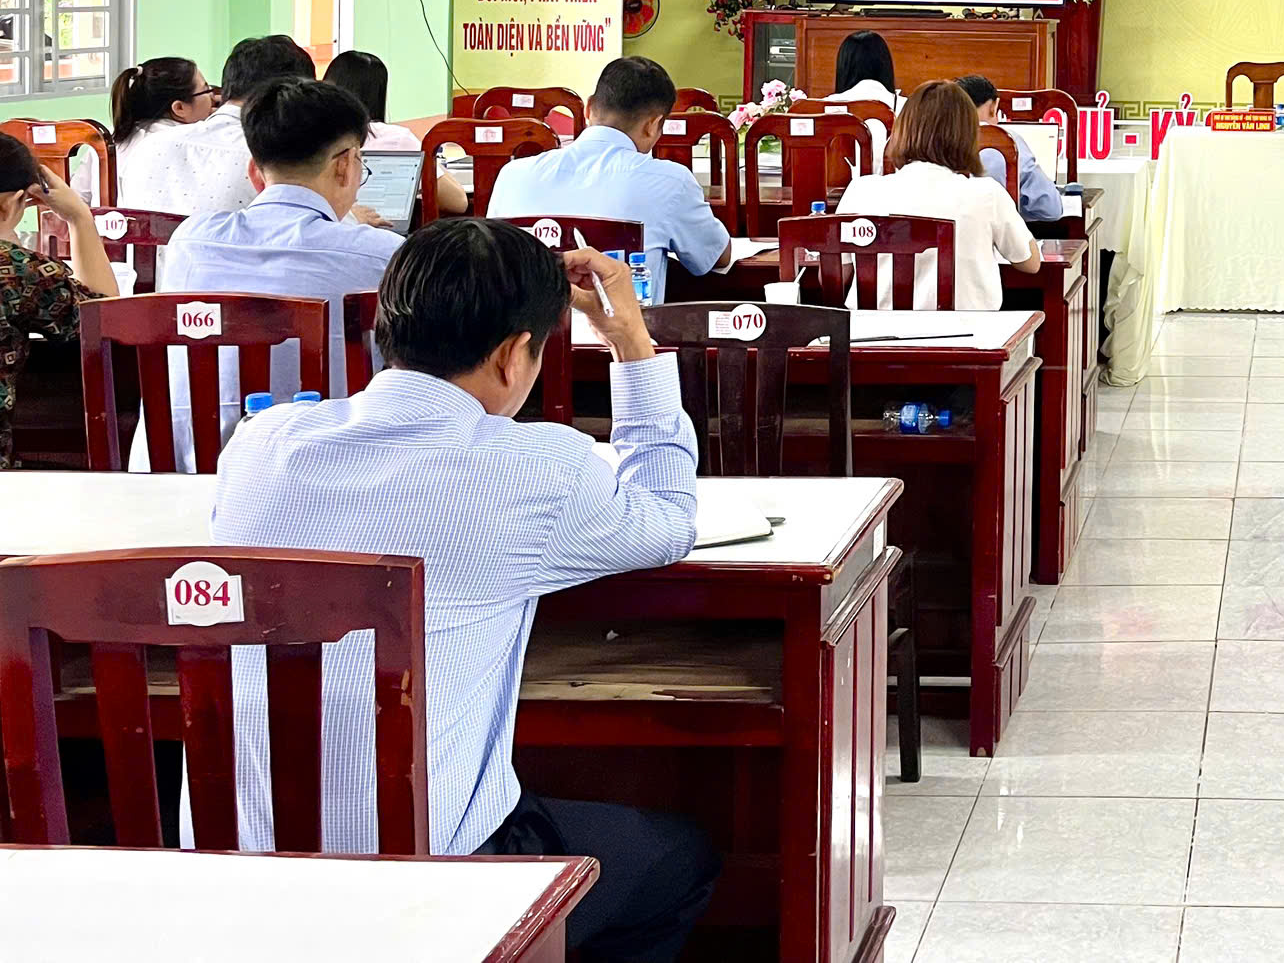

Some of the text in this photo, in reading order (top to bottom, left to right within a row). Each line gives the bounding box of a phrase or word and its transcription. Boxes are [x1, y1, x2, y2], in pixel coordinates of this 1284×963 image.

[463, 17, 493, 50] TOÀN
[496, 17, 524, 57] DIỆN
[528, 18, 543, 51] VÀ
[104, 219, 124, 231] 107
[534, 225, 559, 239] 078
[852, 225, 874, 239] 108
[182, 312, 215, 328] 066
[733, 313, 763, 330] 070
[174, 578, 231, 608] 084
